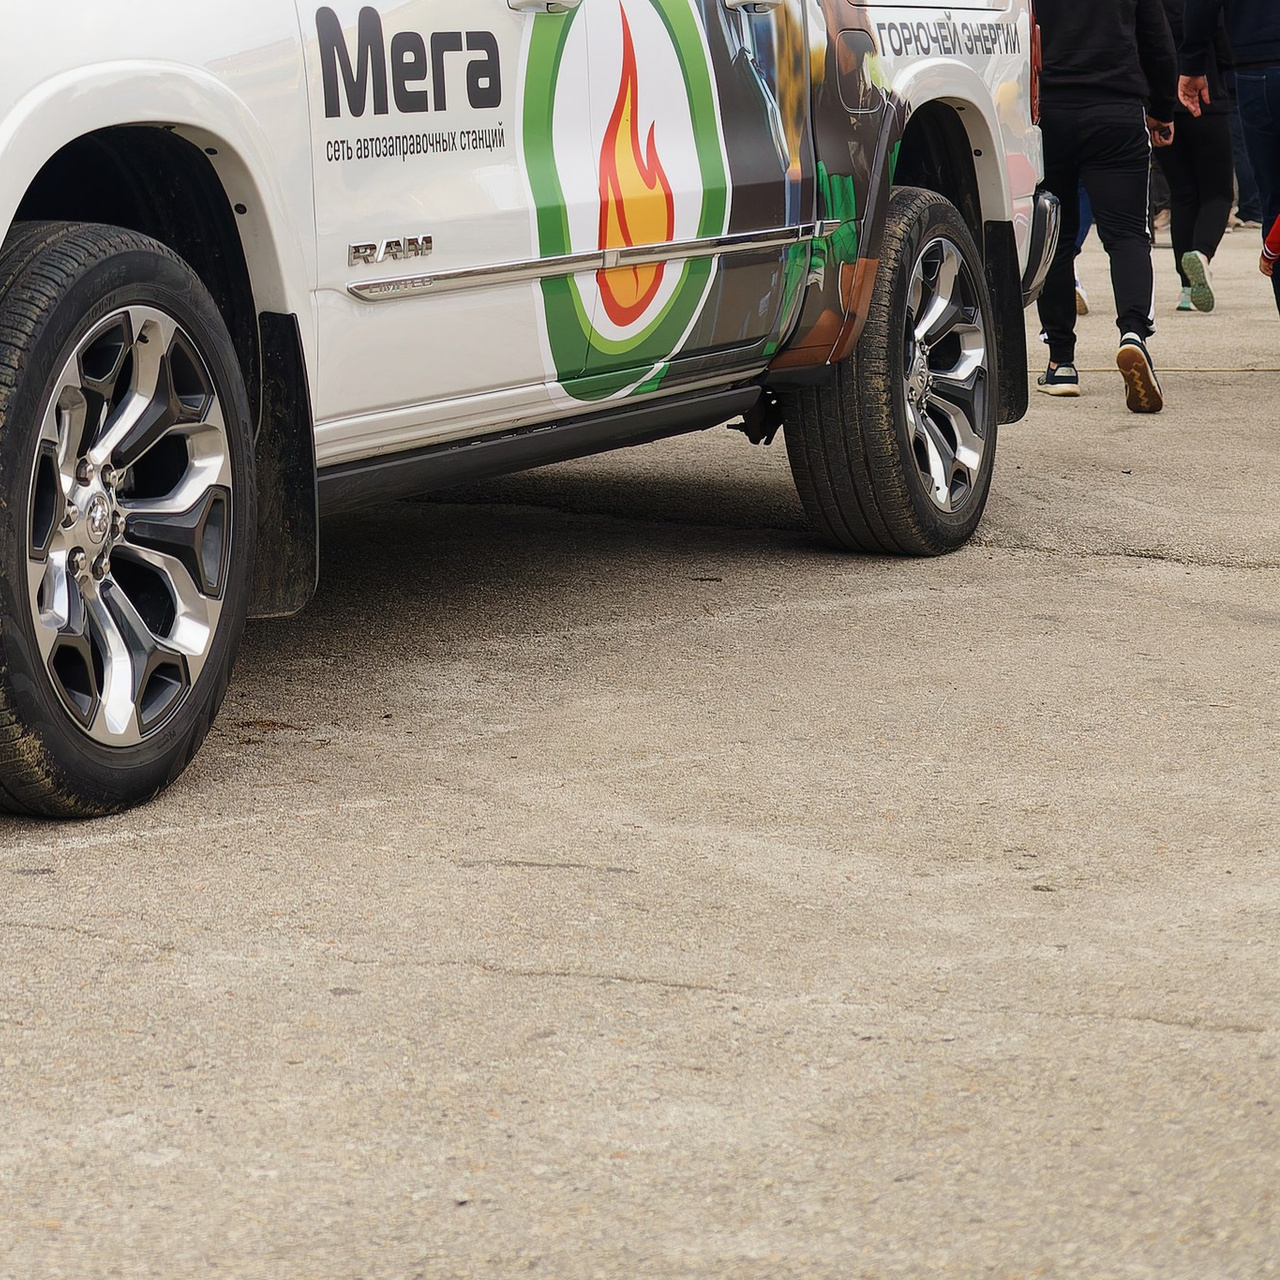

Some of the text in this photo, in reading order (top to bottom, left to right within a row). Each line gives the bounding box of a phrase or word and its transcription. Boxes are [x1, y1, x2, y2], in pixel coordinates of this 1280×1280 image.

[876, 11, 1021, 57] ГОРЮЧЕЙ ЭНЕРГИИ
[315, 6, 501, 118] Мега
[326, 121, 505, 162] сеть автозаправочных станций
[347, 234, 433, 267] RAM
